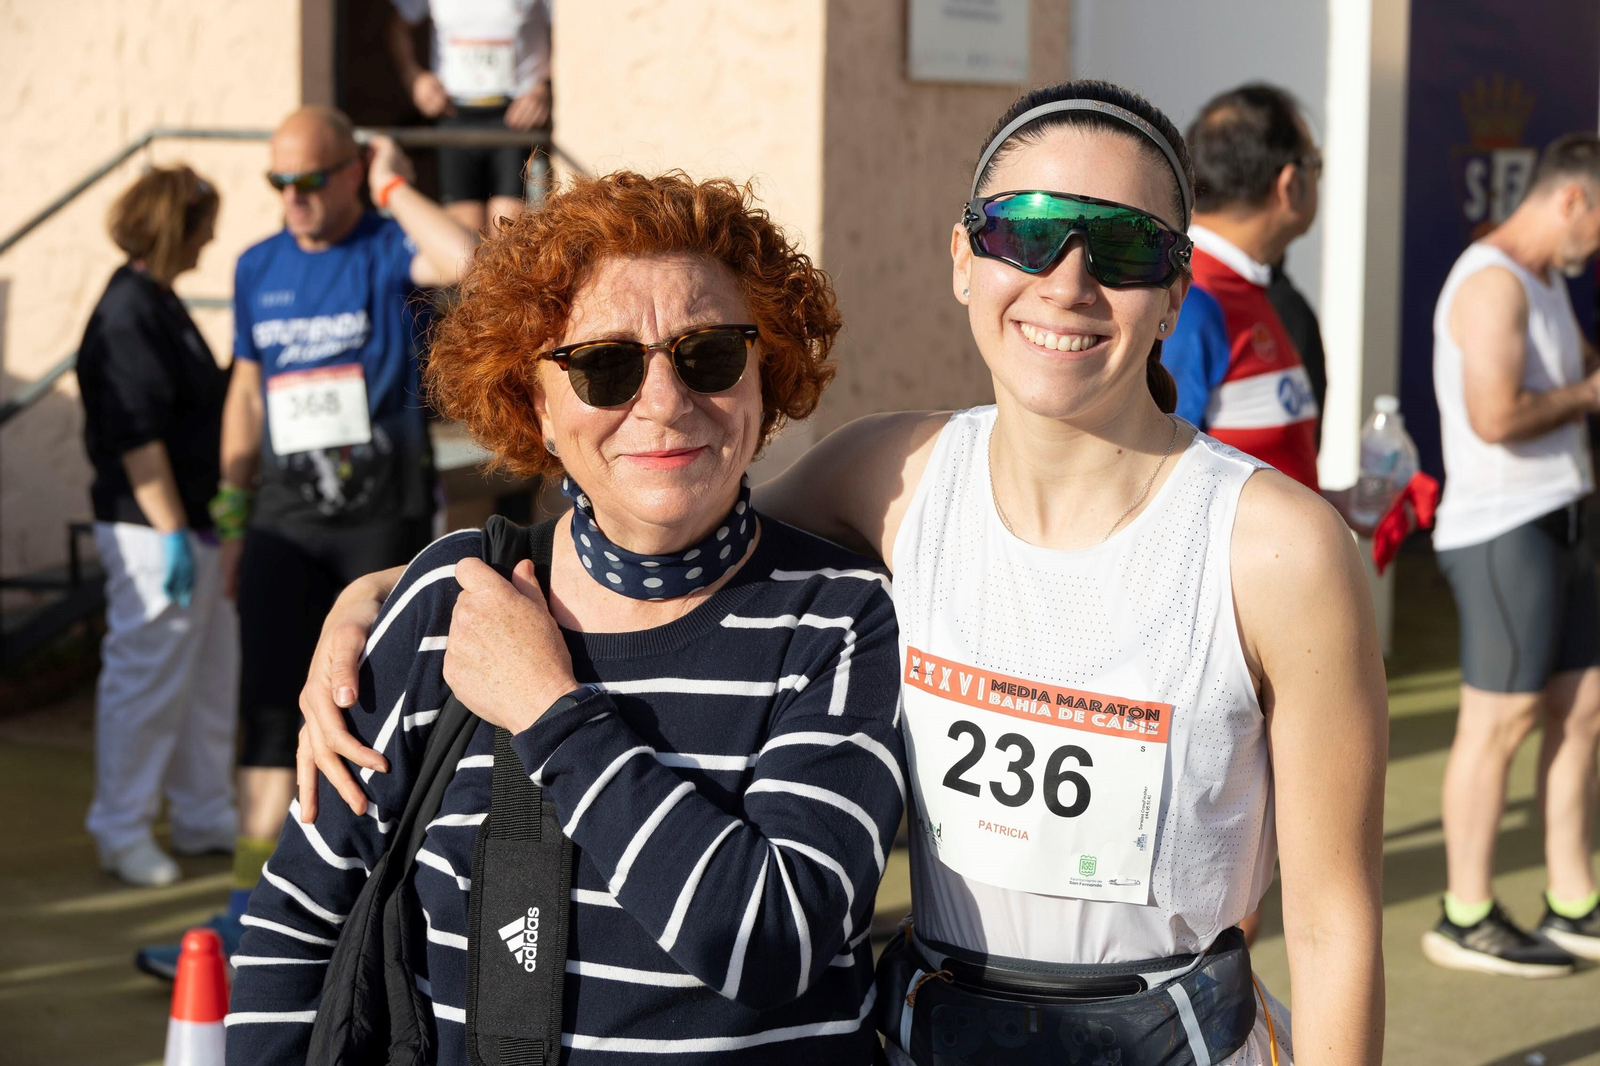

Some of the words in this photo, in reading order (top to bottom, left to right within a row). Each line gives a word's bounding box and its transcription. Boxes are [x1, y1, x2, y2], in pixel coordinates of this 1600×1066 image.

[908, 655, 985, 701] XXXVI
[990, 679, 1051, 703] MEDIA
[1056, 693, 1161, 721] MARATÓN
[988, 691, 1052, 717] BAHÍA
[1058, 707, 1086, 724] DE
[1091, 713, 1160, 735] CÁDIZ
[942, 720, 1094, 818] 236
[1140, 745, 1146, 753] S
[978, 819, 1030, 841] PATRICIA
[524, 906, 540, 973] adidas
